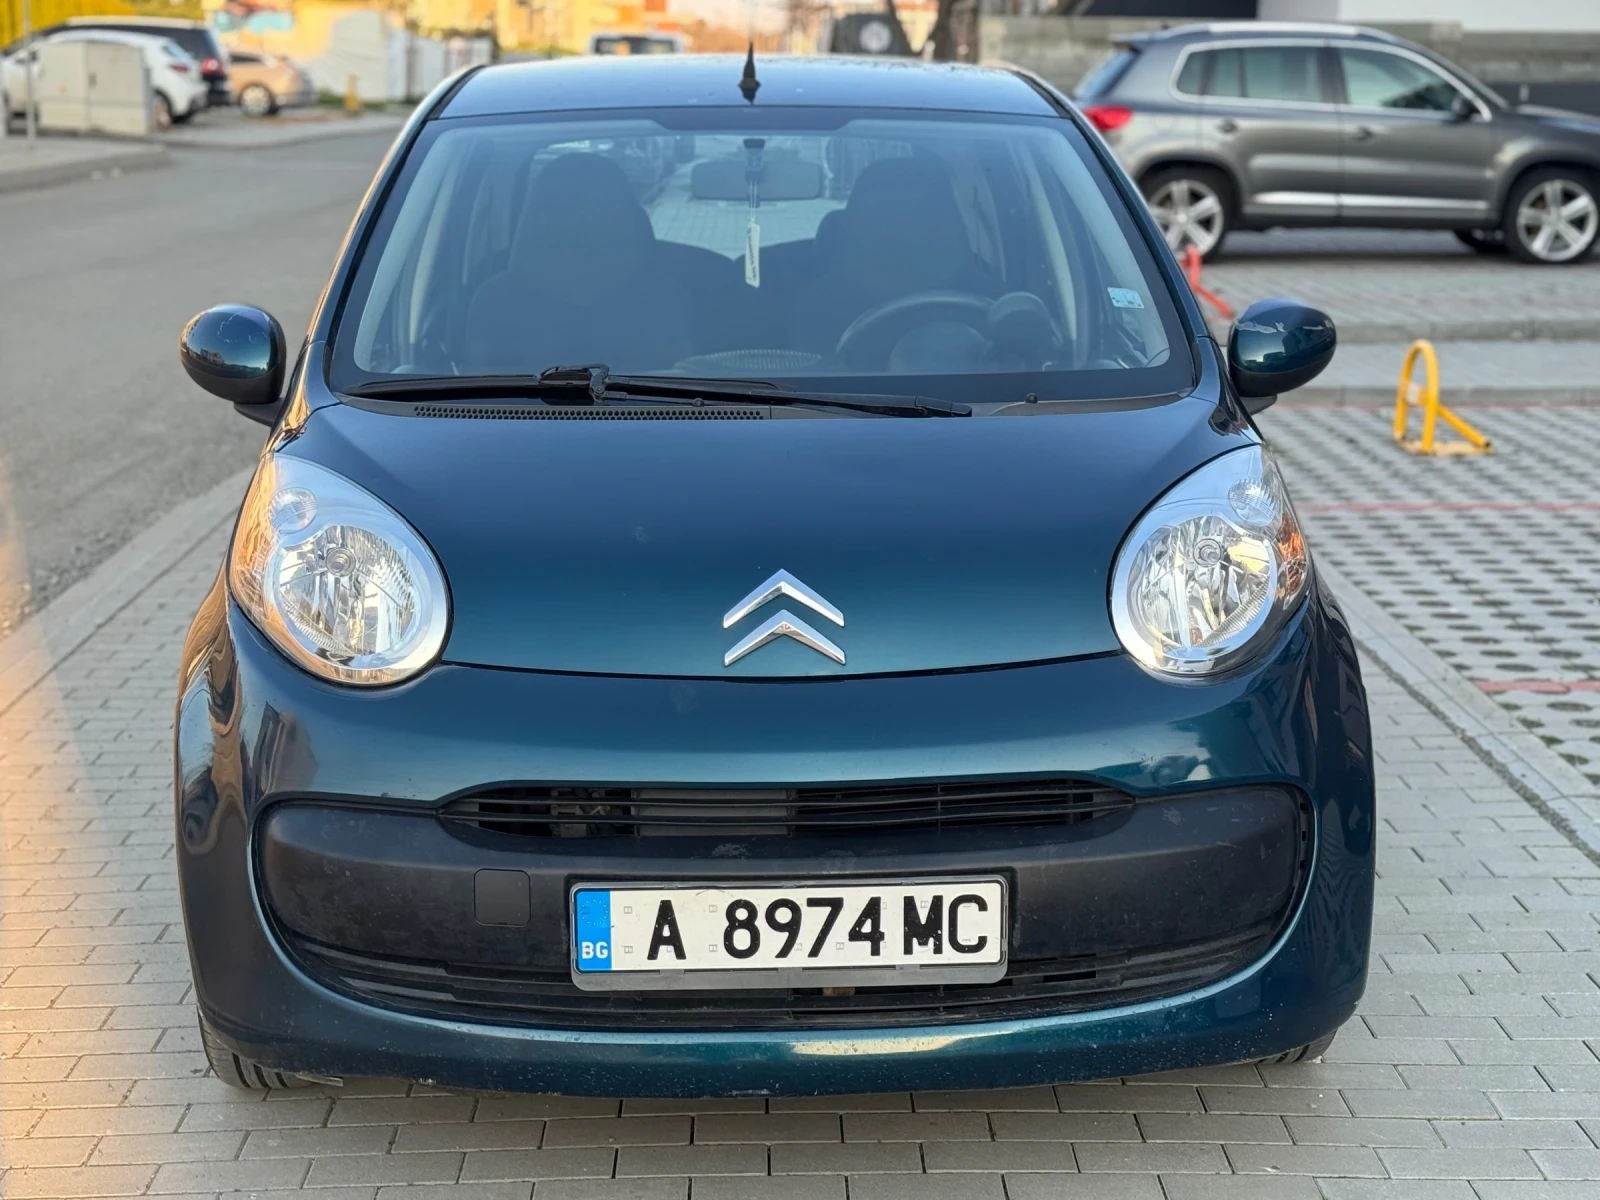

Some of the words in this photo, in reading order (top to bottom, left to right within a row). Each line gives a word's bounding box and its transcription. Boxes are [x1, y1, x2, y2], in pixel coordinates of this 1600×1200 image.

[647, 899, 687, 960] A
[723, 896, 885, 959] 8974
[903, 894, 989, 955] MC
[581, 942, 609, 960] BG
